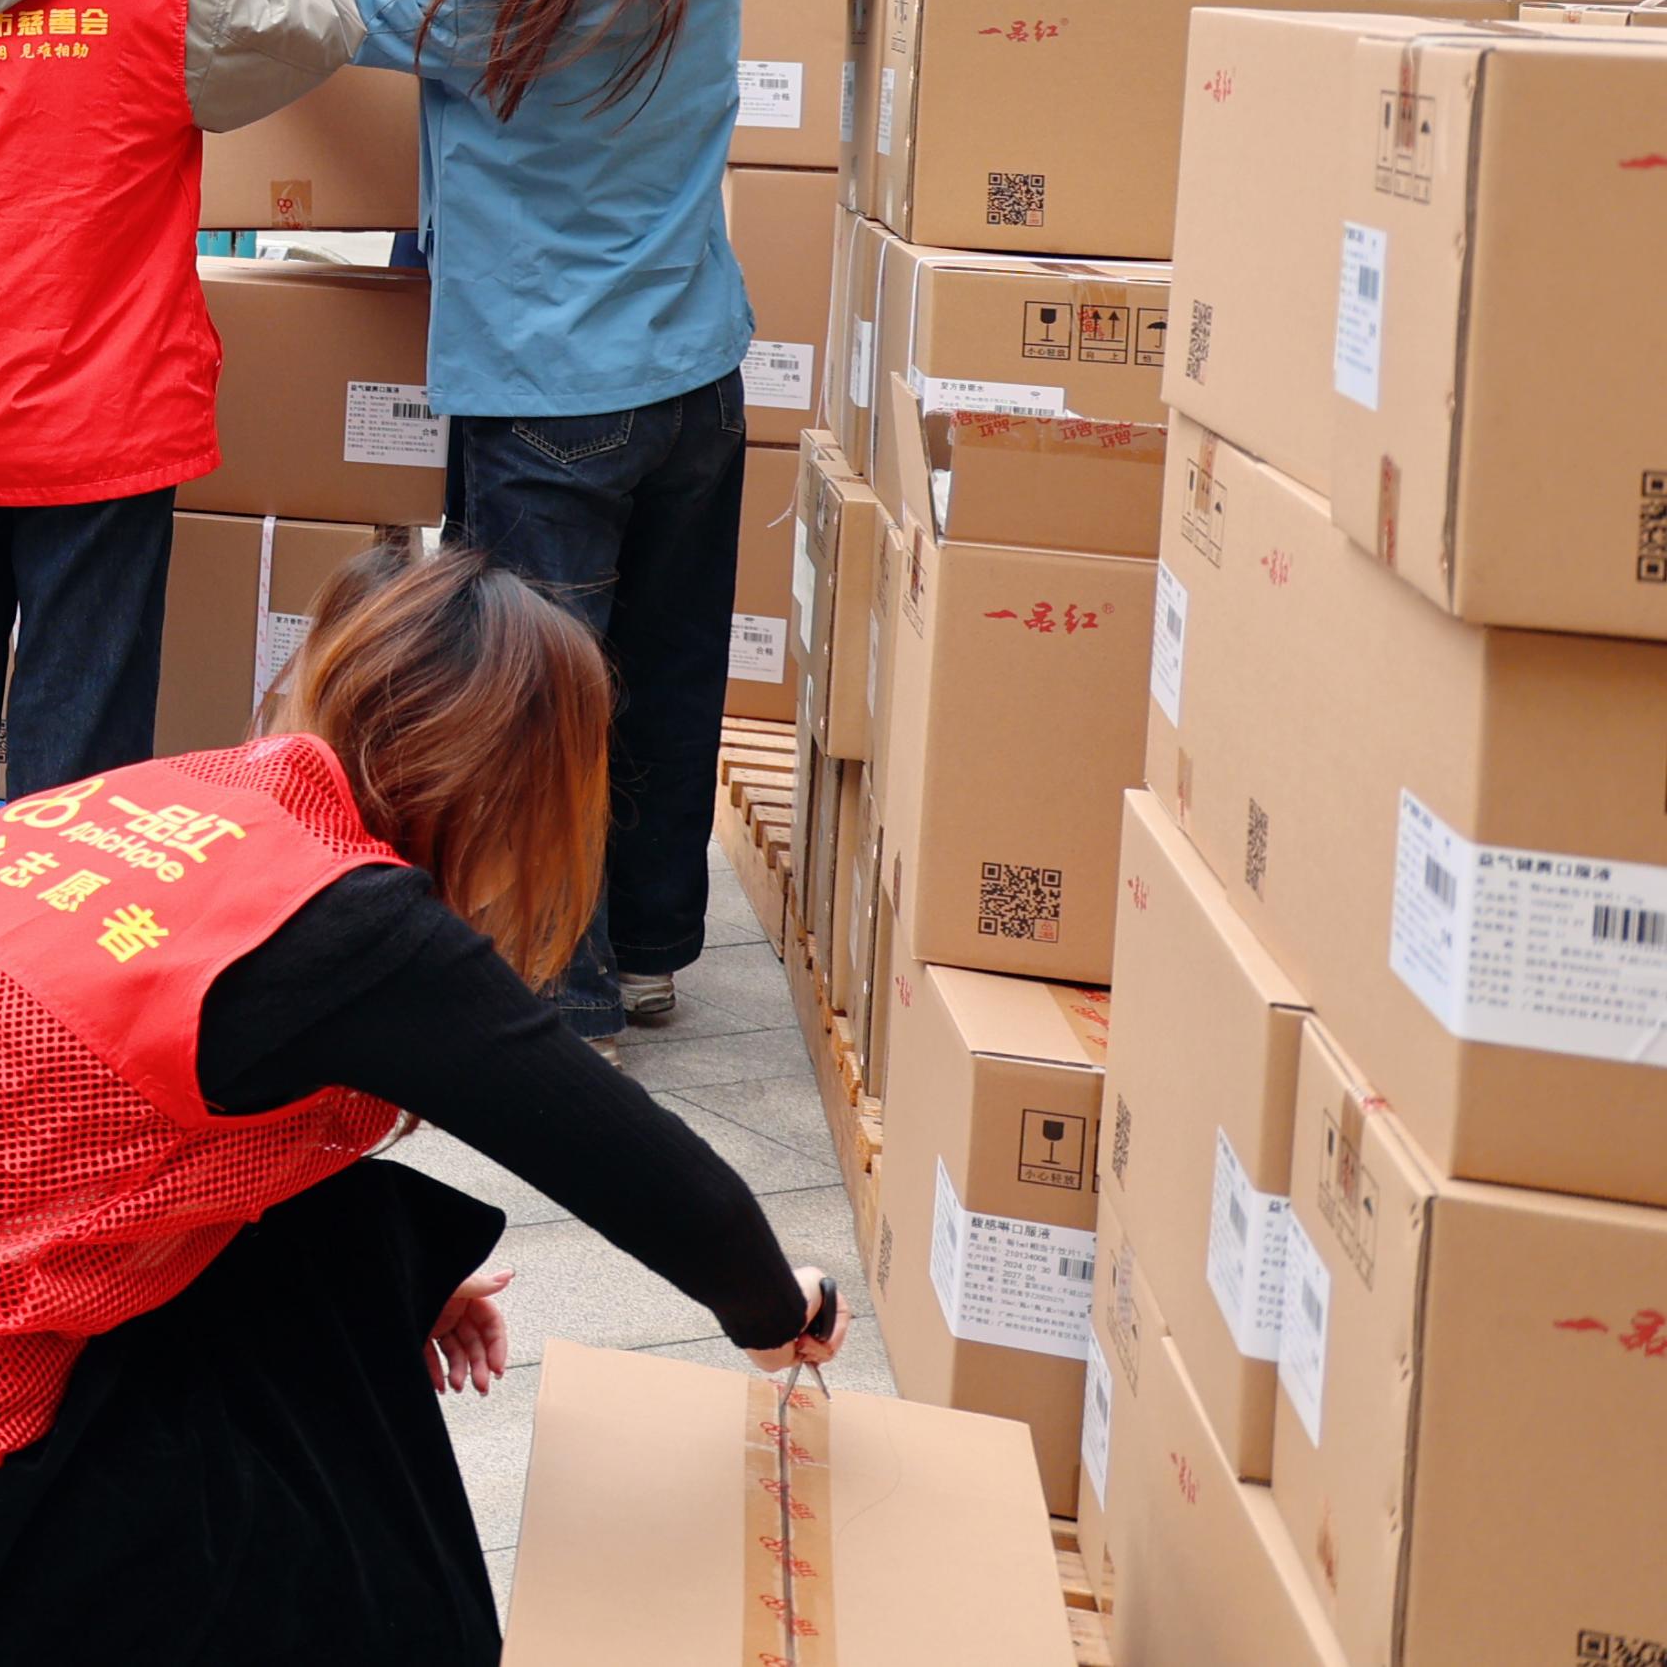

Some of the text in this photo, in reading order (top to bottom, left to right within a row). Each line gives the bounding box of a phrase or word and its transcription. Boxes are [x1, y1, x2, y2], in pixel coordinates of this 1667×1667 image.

[983, 602, 1099, 634] 一品红
[58, 820, 185, 883] ApicHope
[107, 795, 247, 863] 一品红
